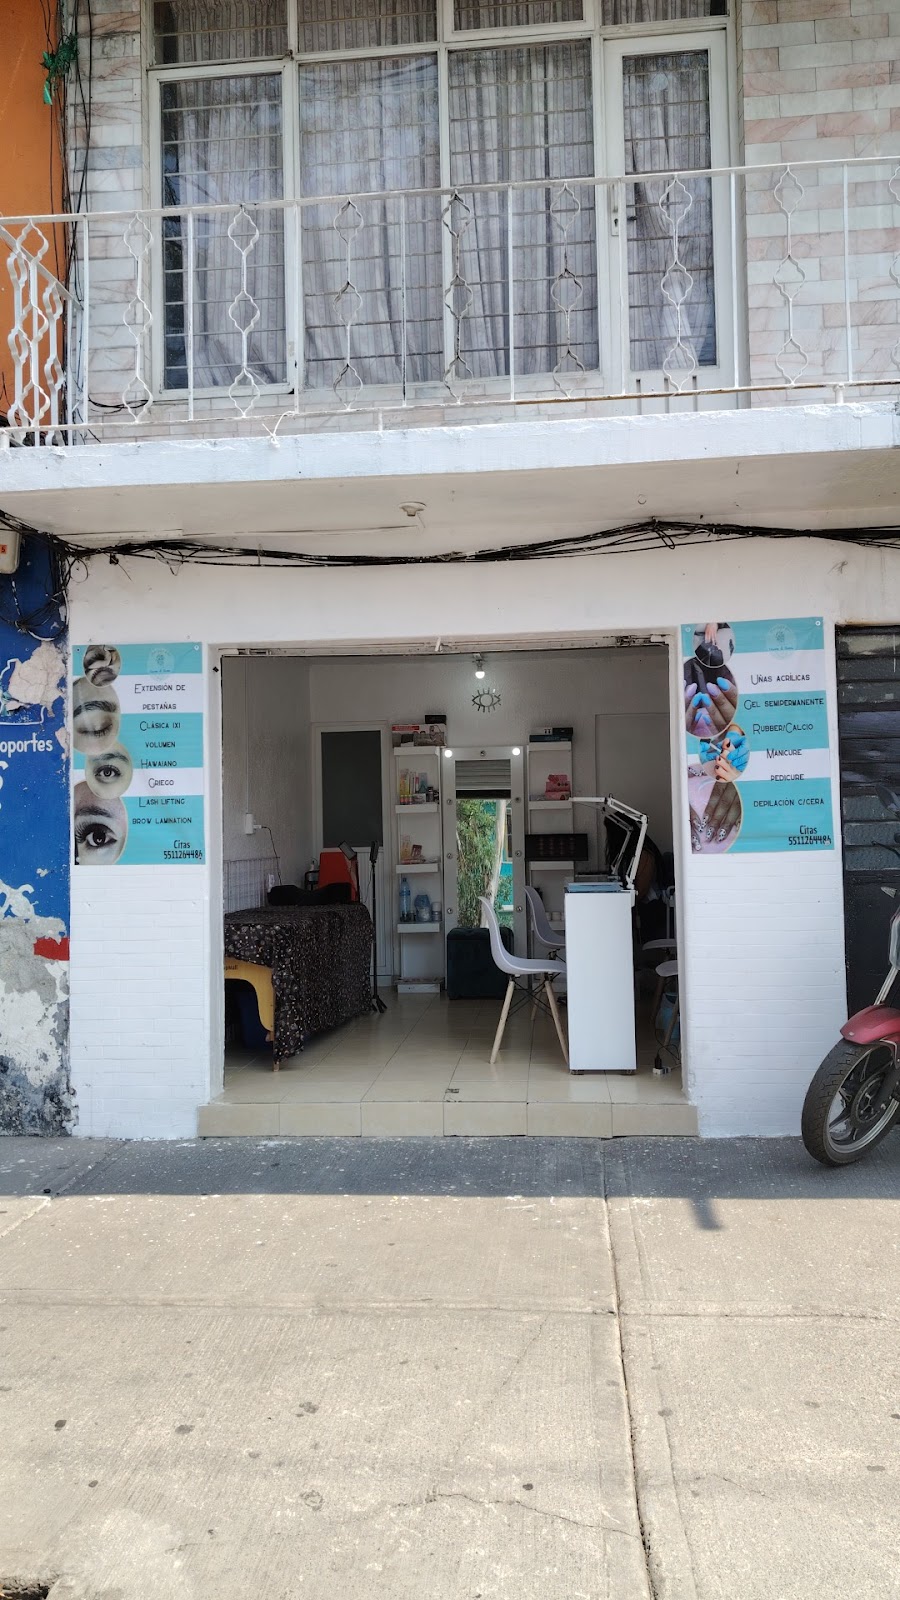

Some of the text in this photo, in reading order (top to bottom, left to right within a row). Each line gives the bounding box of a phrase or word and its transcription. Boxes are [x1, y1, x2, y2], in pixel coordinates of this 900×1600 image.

[751, 672, 810, 685] UÑAS ACRÍLICAS
[134, 683, 173, 693] EXTENSIÓN
[142, 702, 177, 710] PESTAÑAS
[743, 697, 824, 710] GEL SEMIPERMANENTE
[139, 720, 169, 731] CLÁSICA
[752, 722, 814, 734] RUBBER/CALCIO
[766, 748, 802, 759] MANICURE
[140, 759, 177, 769] HAWAIANO
[148, 778, 175, 788] GRIEGO
[138, 797, 185, 808] LASH LIFTING
[753, 798, 795, 808] DEPILACIÓN
[155, 817, 192, 825] LAMINATION
[800, 825, 818, 835] Citas
[173, 840, 191, 849] Citas
